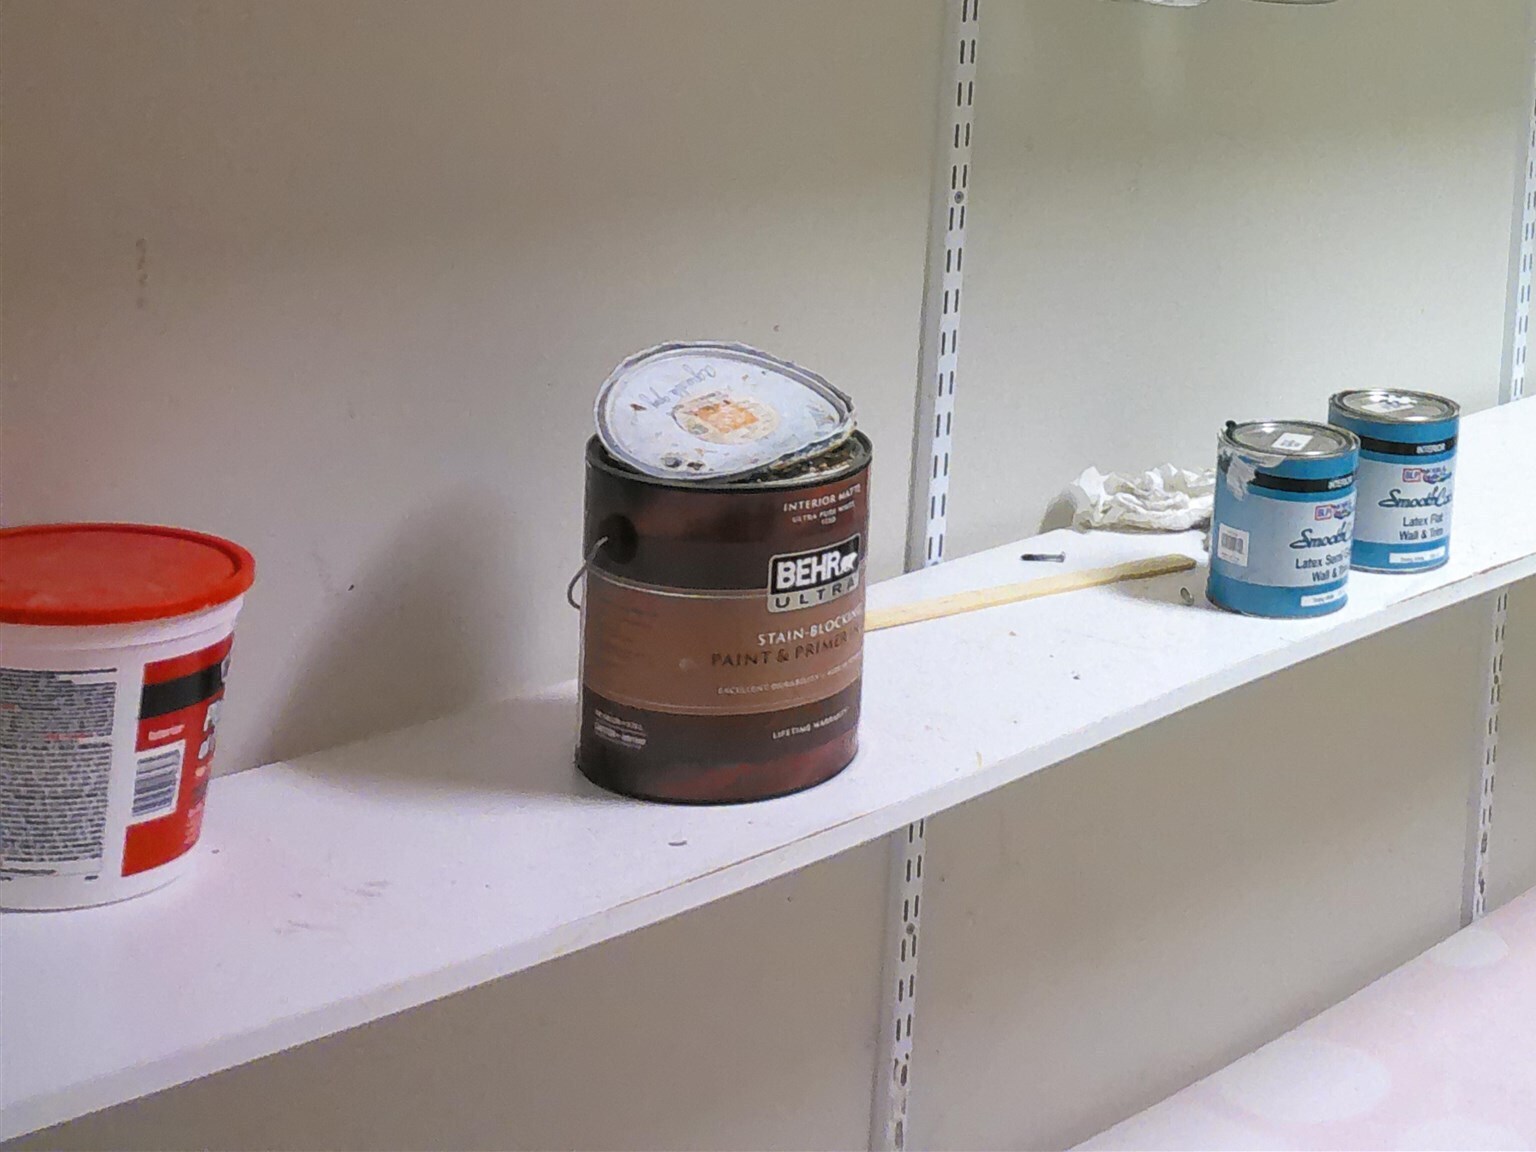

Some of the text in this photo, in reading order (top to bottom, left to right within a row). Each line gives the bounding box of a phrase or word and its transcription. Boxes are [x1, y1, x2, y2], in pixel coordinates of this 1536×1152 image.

[783, 494, 836, 512] INTERIOR
[1403, 515, 1428, 527] Latex
[1400, 530, 1418, 540] Wall
[776, 550, 840, 589] BEHR
[1296, 558, 1322, 569] Latex
[1312, 570, 1330, 582] Wall
[775, 576, 855, 608] ULTRA
[711, 631, 847, 666] PAINT & PRIMER
